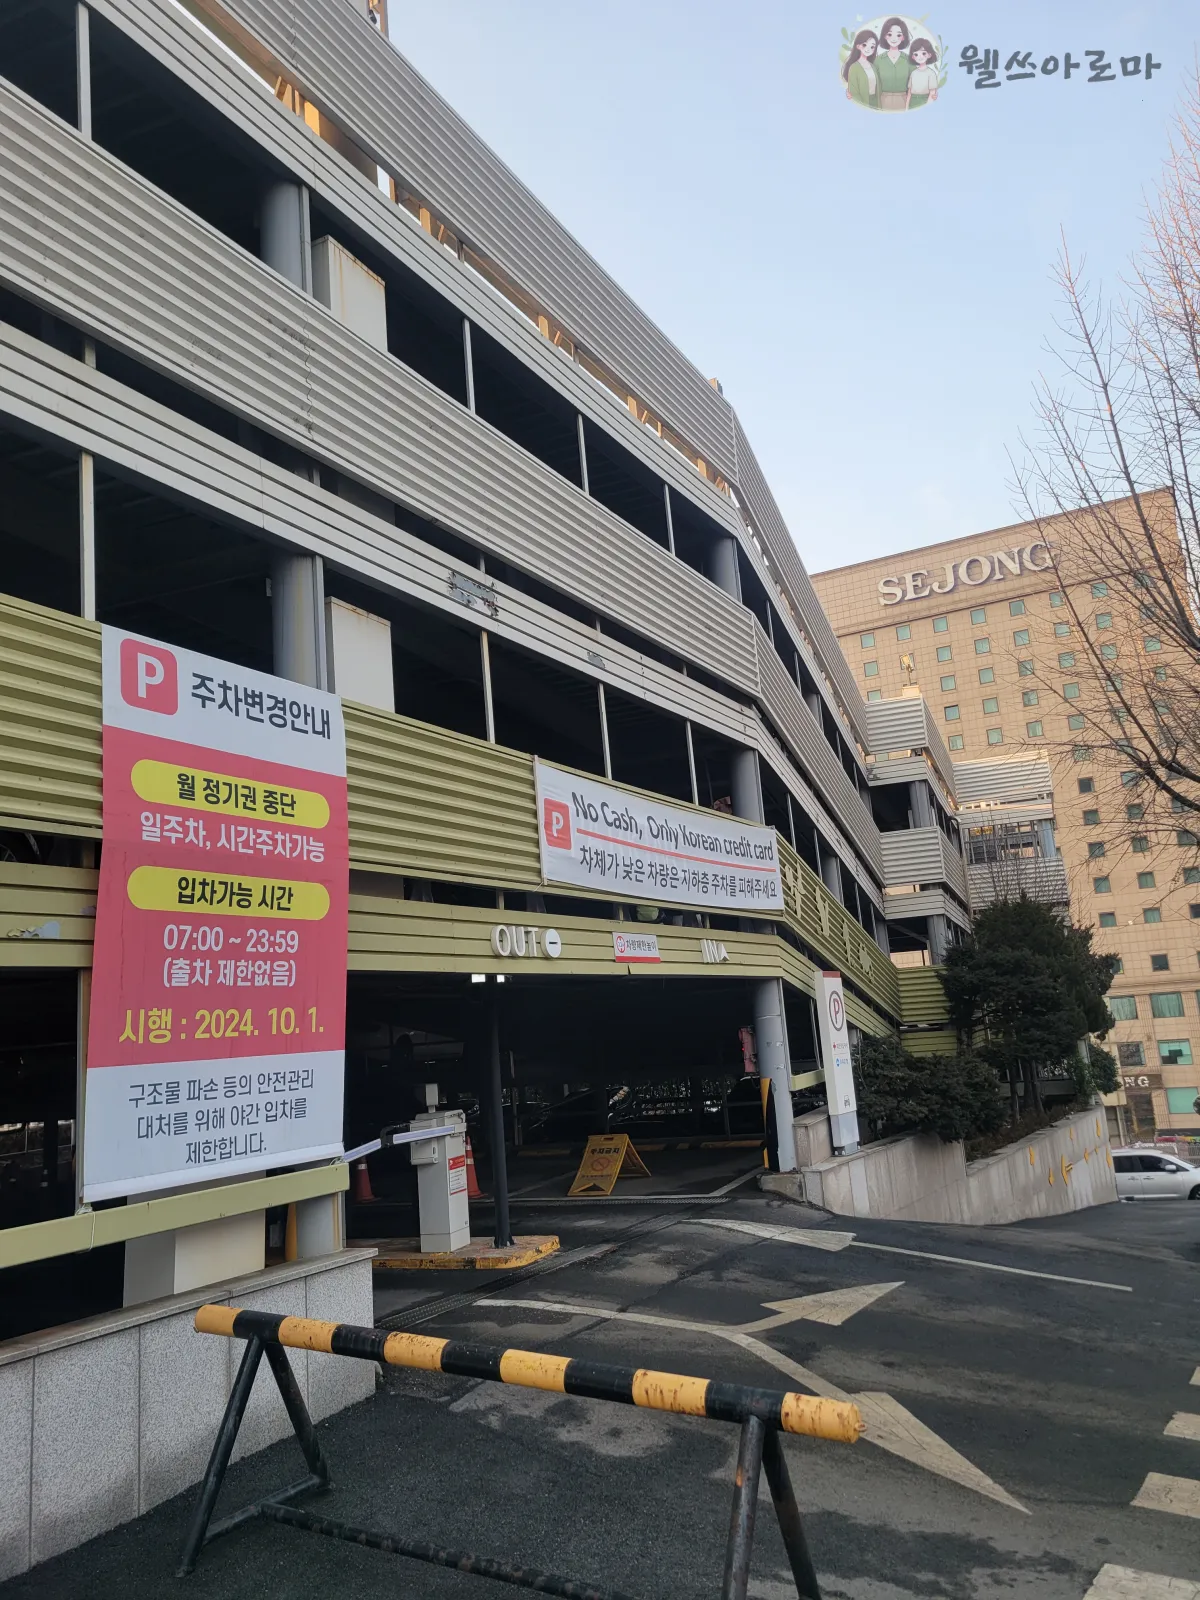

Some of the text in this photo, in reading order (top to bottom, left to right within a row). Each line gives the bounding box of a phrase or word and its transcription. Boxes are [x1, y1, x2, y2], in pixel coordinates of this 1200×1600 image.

[877, 540, 1059, 606] SEJONG
[137, 652, 165, 698] P
[191, 671, 331, 740] 주차변경안내
[176, 772, 297, 818] 월 정기권 중단
[140, 811, 325, 863] 일주차, 시간주차가능
[551, 811, 564, 837] P
[571, 791, 774, 861] No Cash, Only Korean credit card
[579, 845, 777, 899] 차체가 낮은 차량은 지하층 주차를 피해주세요
[177, 876, 294, 912] 입차가능 시간
[163, 924, 224, 952] 07:00
[245, 928, 299, 953] 23:59
[490, 924, 538, 958] OUT
[700, 939, 720, 964] IN
[163, 957, 296, 988] (출차 제한없음)
[118, 1007, 172, 1044] 시행
[194, 1008, 259, 1038] 2024.
[268, 1006, 300, 1035] 10.
[307, 1006, 324, 1033] 1.
[128, 1068, 314, 1109] 구조물 파손 등의 안전관리
[137, 1097, 307, 1140] 대처를 위해 야간 입차를
[185, 1131, 267, 1165] 제한합니다.
